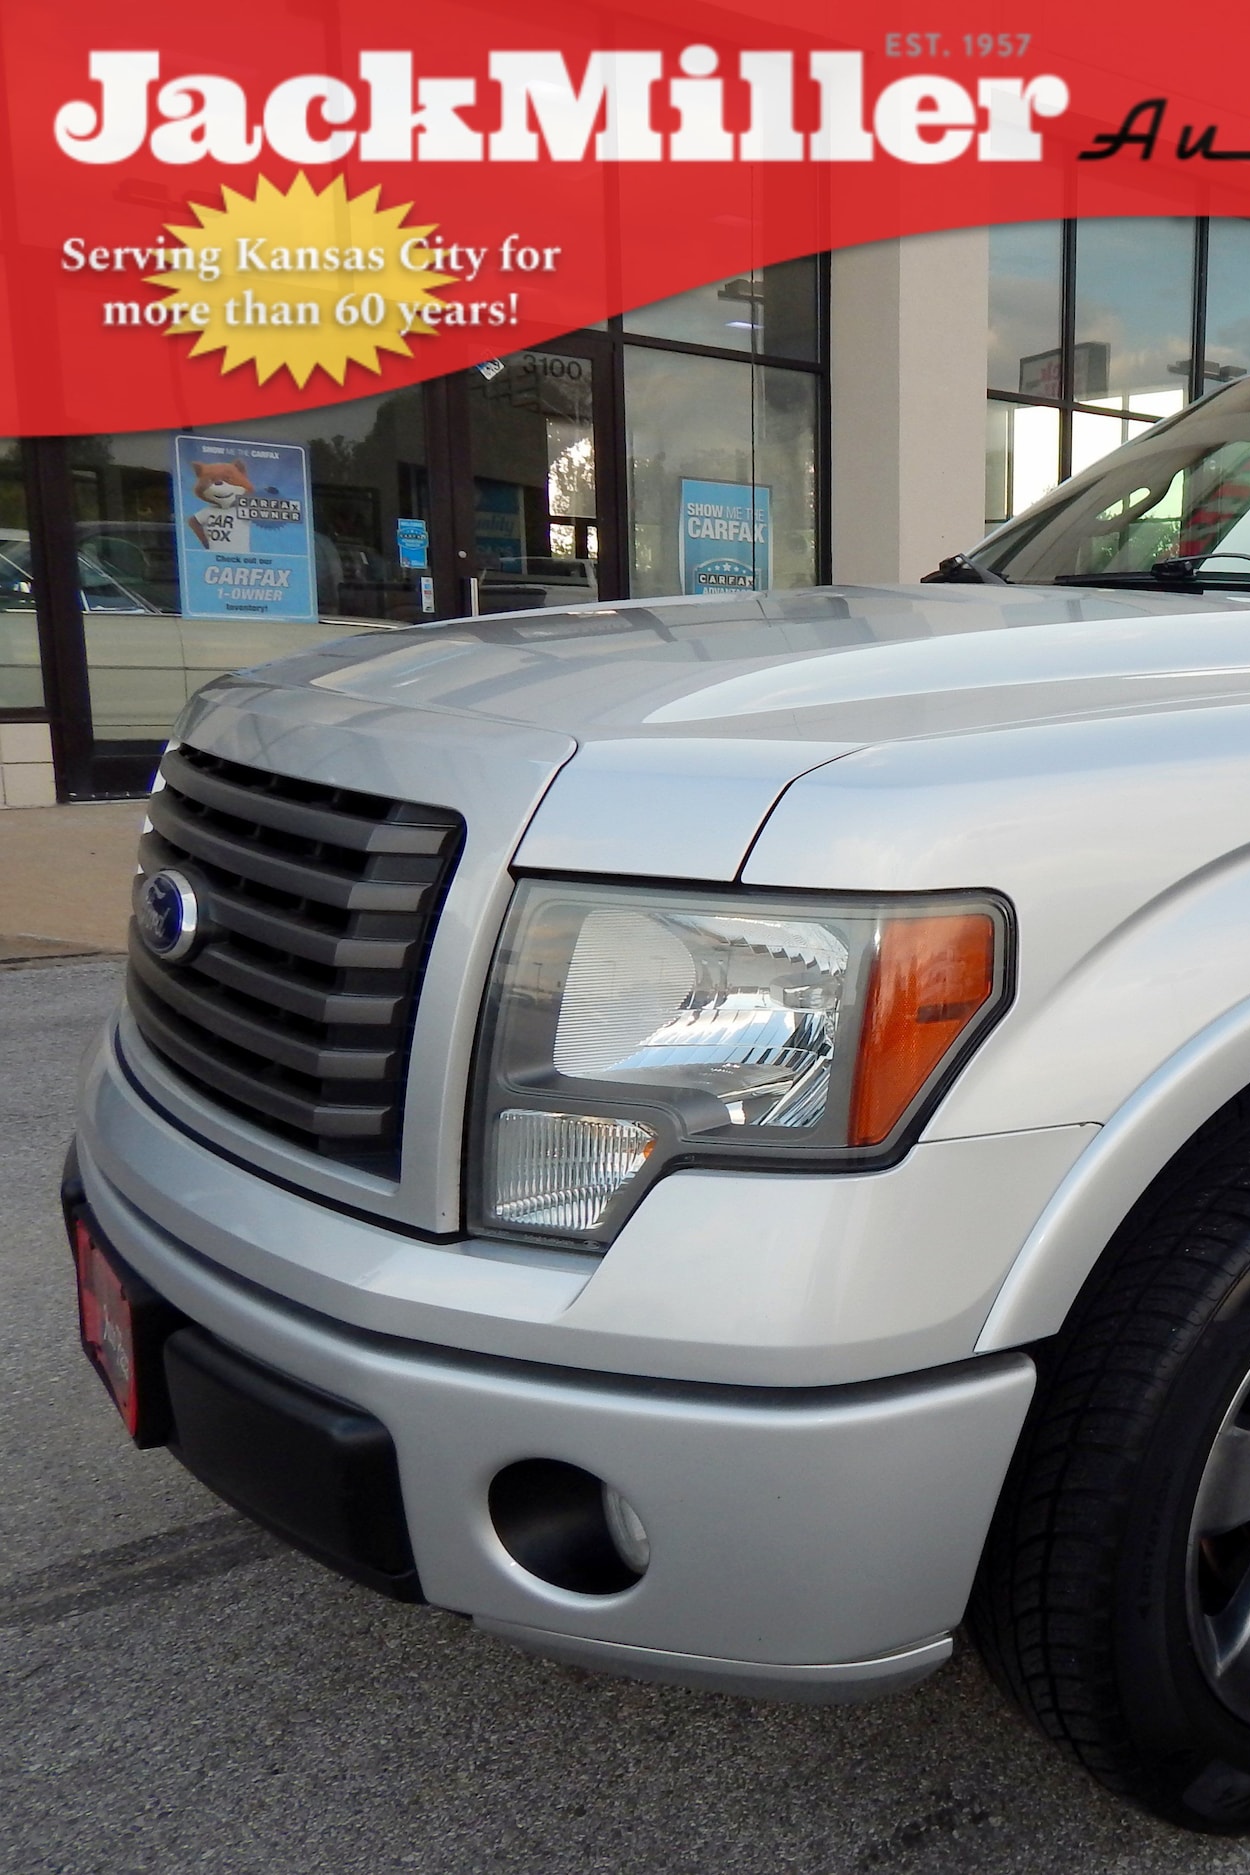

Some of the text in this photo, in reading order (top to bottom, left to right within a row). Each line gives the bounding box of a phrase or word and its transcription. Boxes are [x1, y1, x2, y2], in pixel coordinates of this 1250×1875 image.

[522, 354, 582, 380] 3100
[239, 498, 300, 512] CARFAX
[687, 502, 764, 521] SHOW ME THE
[687, 517, 767, 544] CARFAX
[216, 554, 241, 564] Check
[204, 565, 292, 588] CARFAX
[217, 588, 283, 602] 1-OWNER
